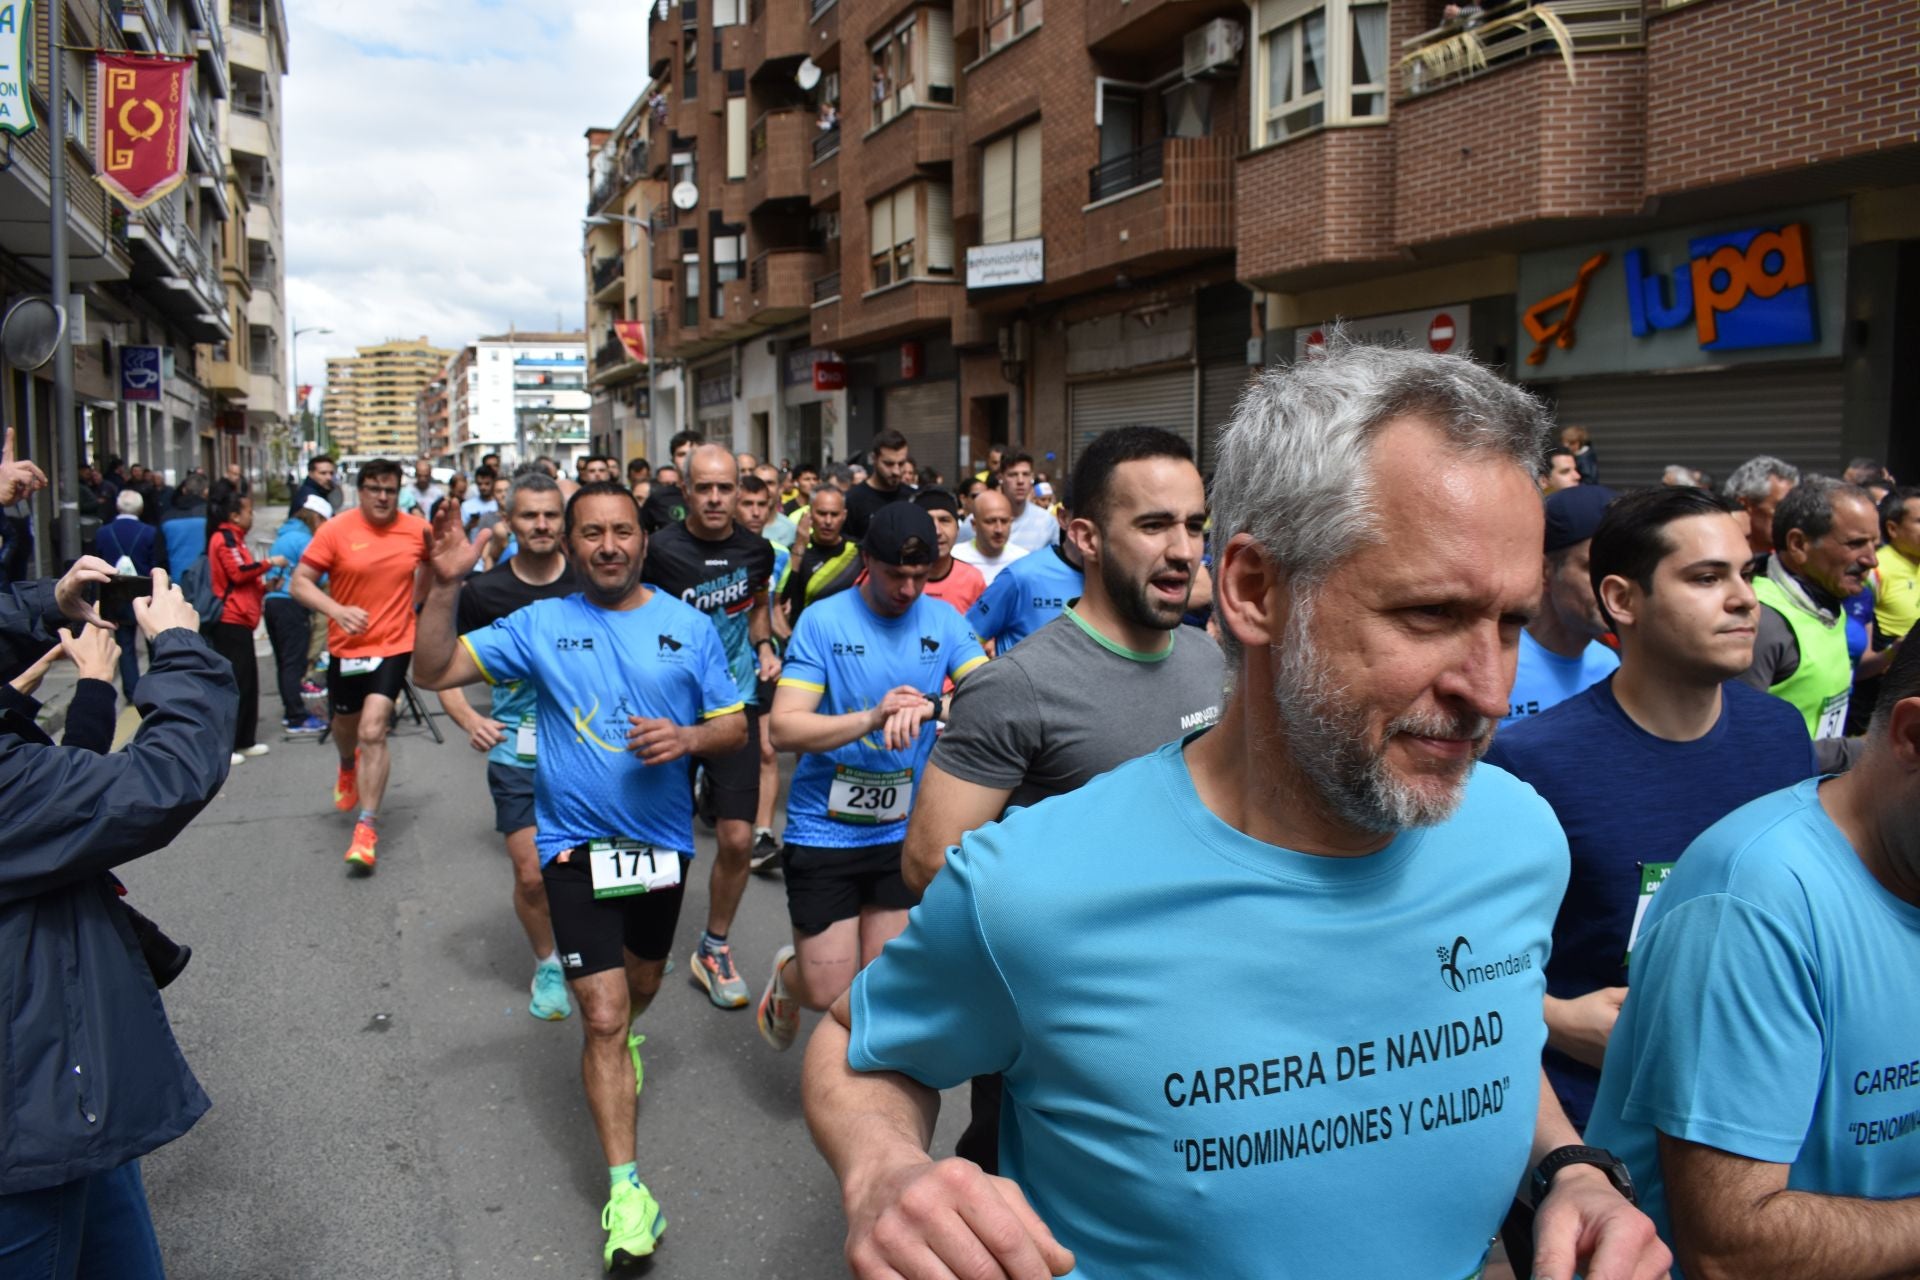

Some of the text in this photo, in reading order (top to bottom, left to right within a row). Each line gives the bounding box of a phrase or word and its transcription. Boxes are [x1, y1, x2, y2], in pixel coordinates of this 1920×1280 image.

[1624, 223, 1813, 345] lupa
[847, 785, 896, 809] 230
[609, 847, 656, 878] 171
[1467, 951, 1532, 985] mendavia
[1164, 1010, 1503, 1108] CARRERA DE NAVIDAD
[1399, 1102, 1414, 1136] Y
